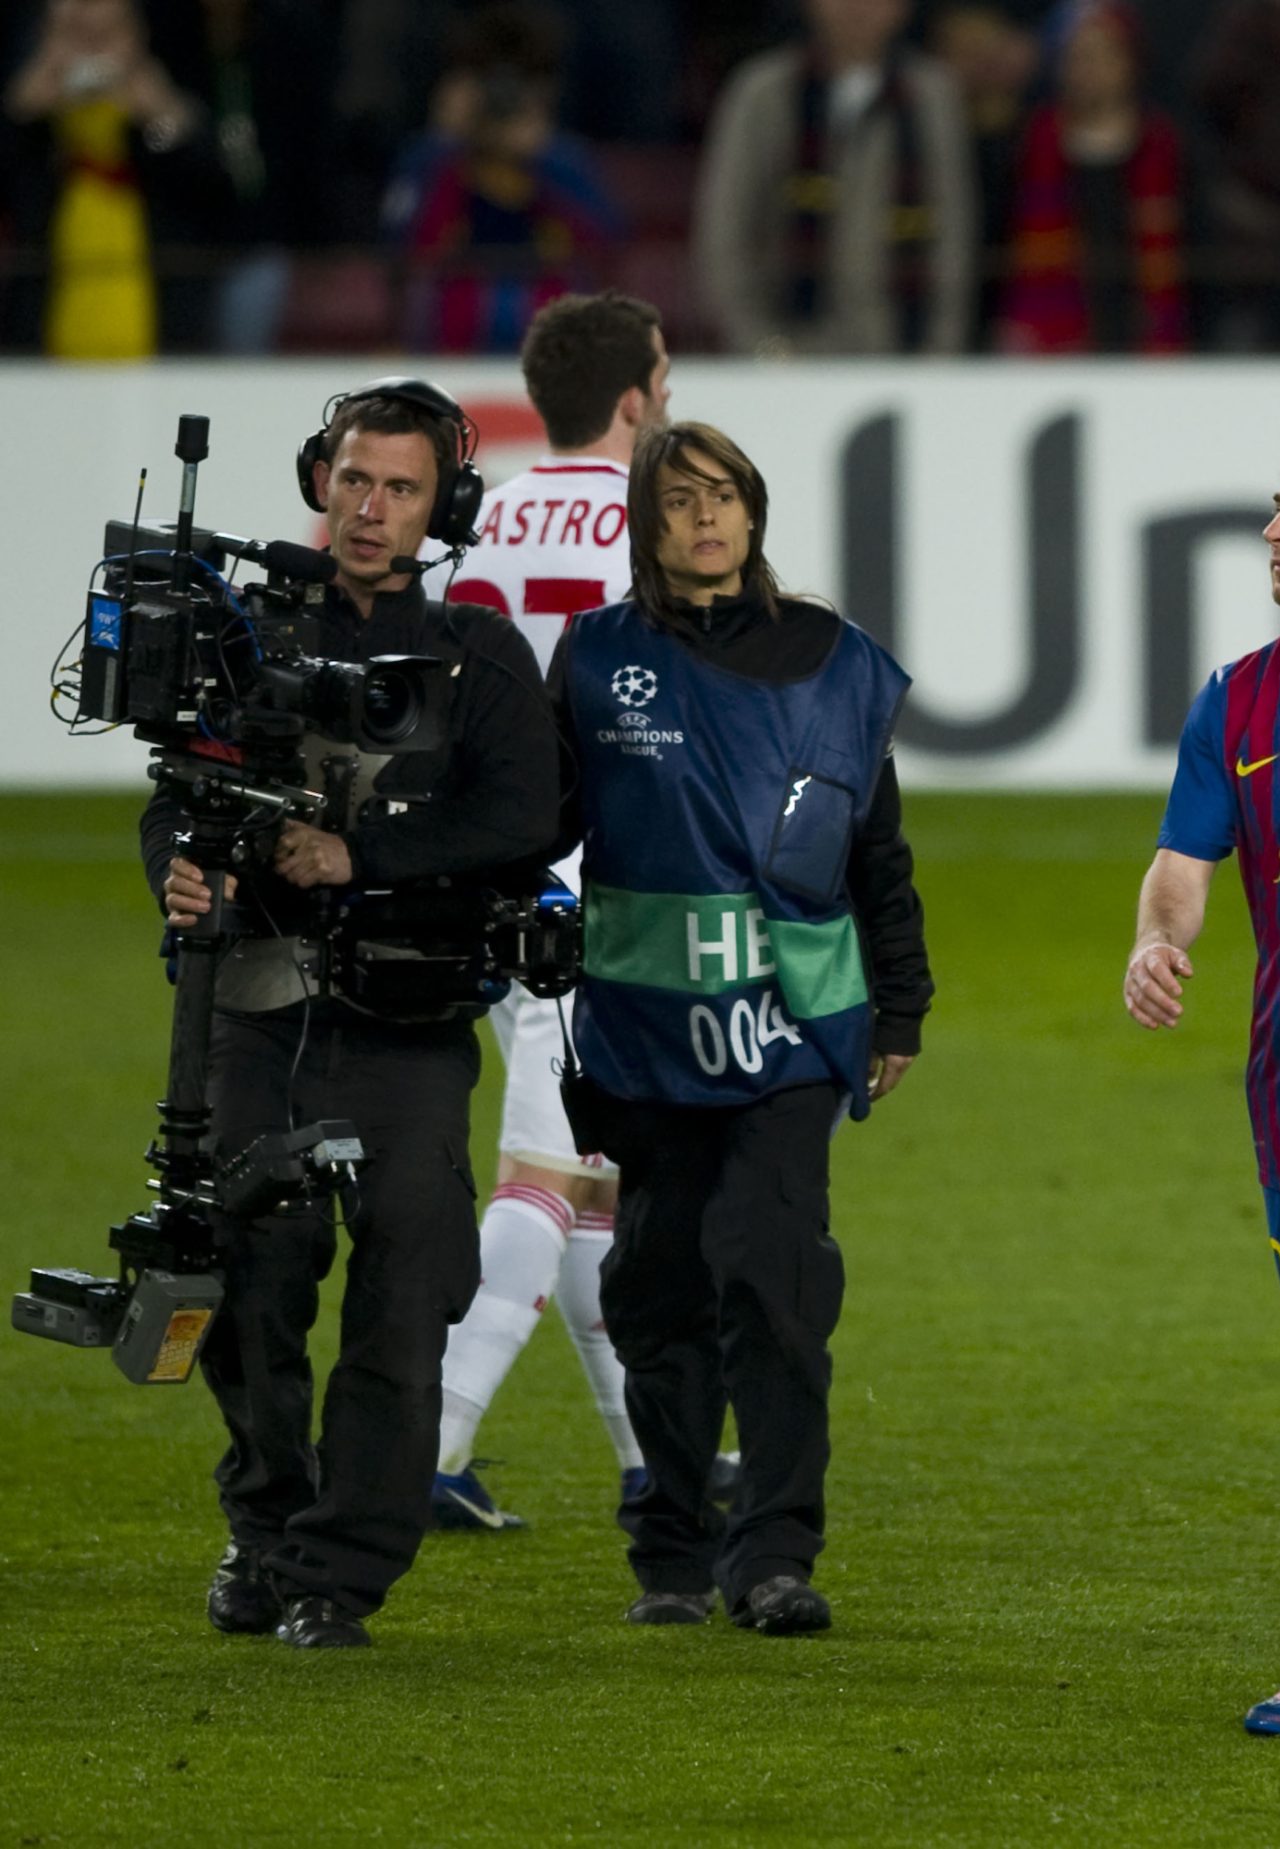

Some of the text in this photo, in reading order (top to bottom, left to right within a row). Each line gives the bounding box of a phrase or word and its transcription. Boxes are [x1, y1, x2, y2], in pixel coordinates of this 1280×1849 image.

[477, 499, 628, 547] ASTRO
[598, 730, 684, 744] CHAMPIONS
[689, 990, 803, 1076] 004
